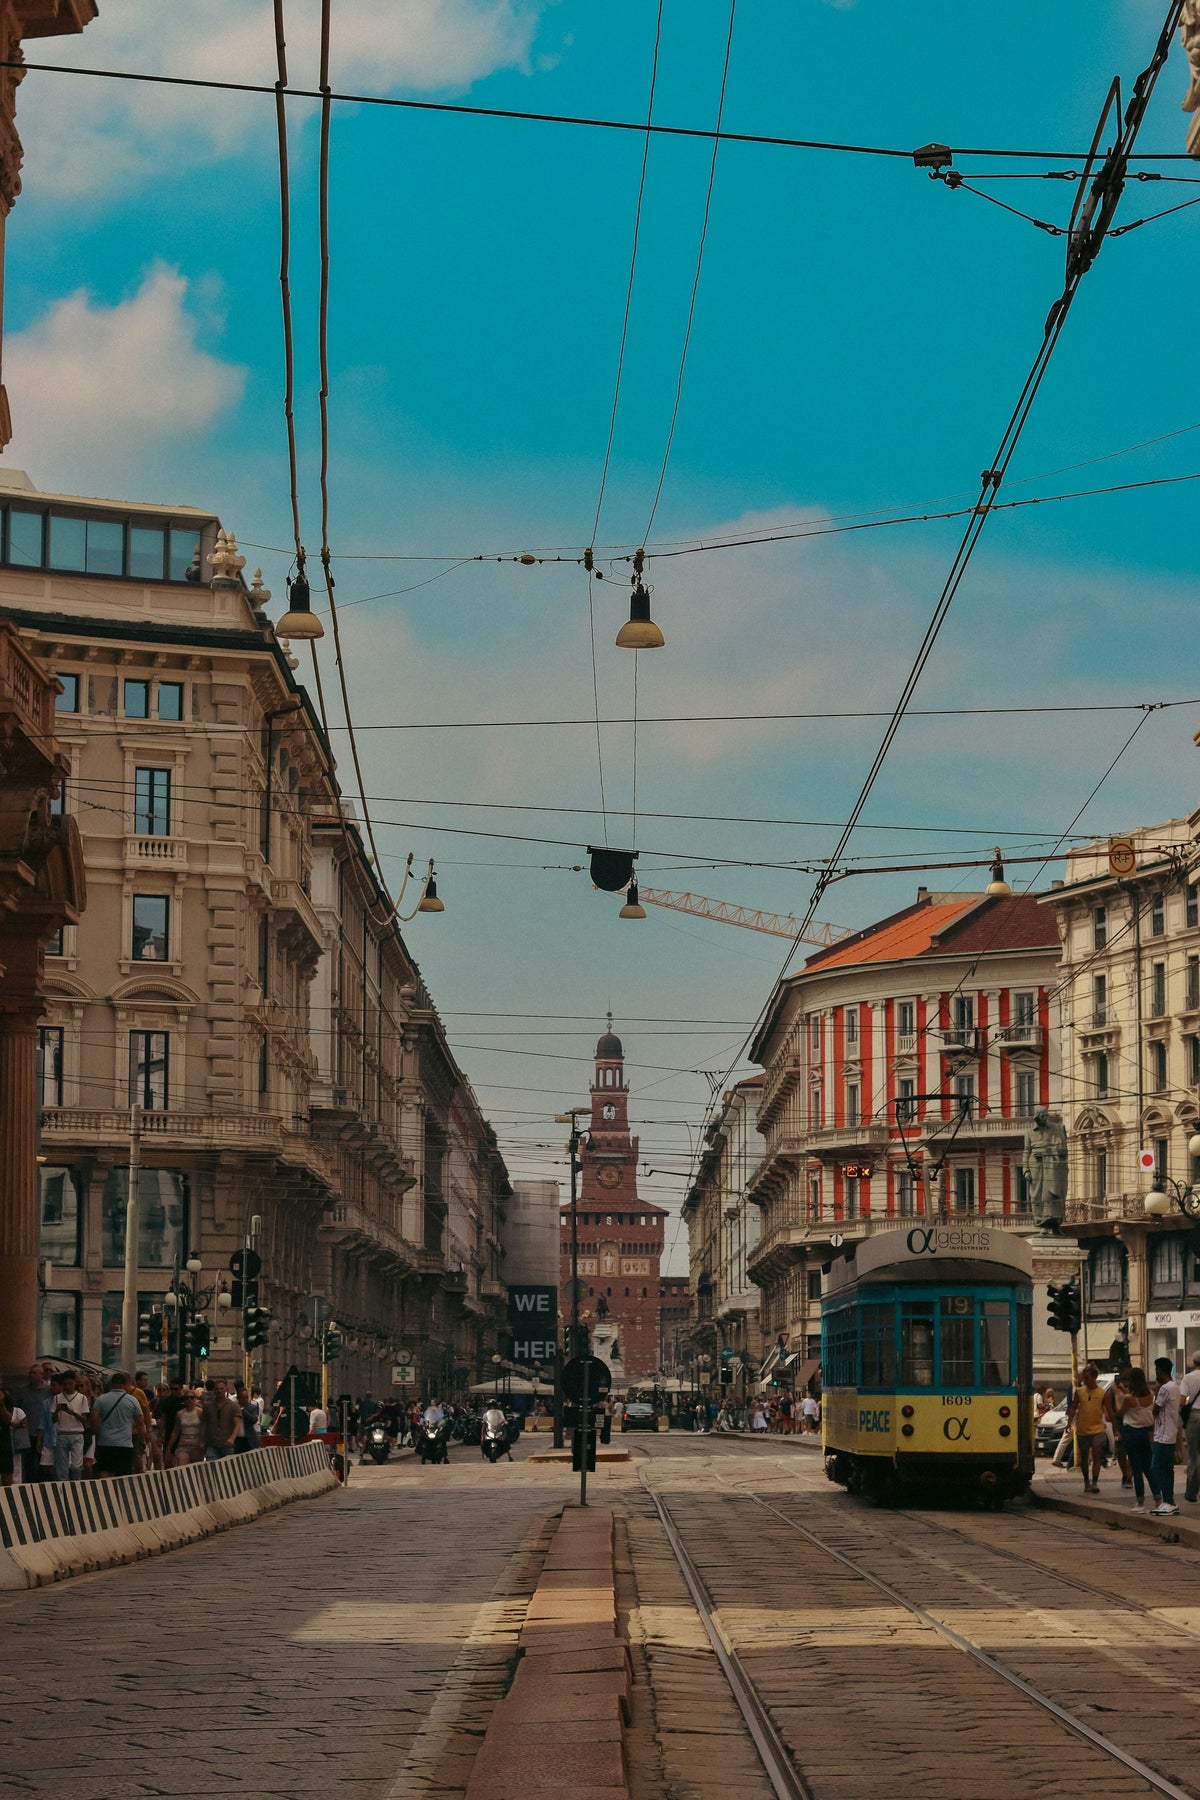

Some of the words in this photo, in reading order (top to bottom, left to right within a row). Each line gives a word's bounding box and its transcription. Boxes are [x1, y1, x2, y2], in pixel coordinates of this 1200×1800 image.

[514, 1294, 550, 1312] WE
[947, 1297, 968, 1314] 19
[1155, 1314, 1171, 1323] KIKO
[942, 1396, 972, 1406] 1609
[859, 1410, 890, 1433] PEACE
